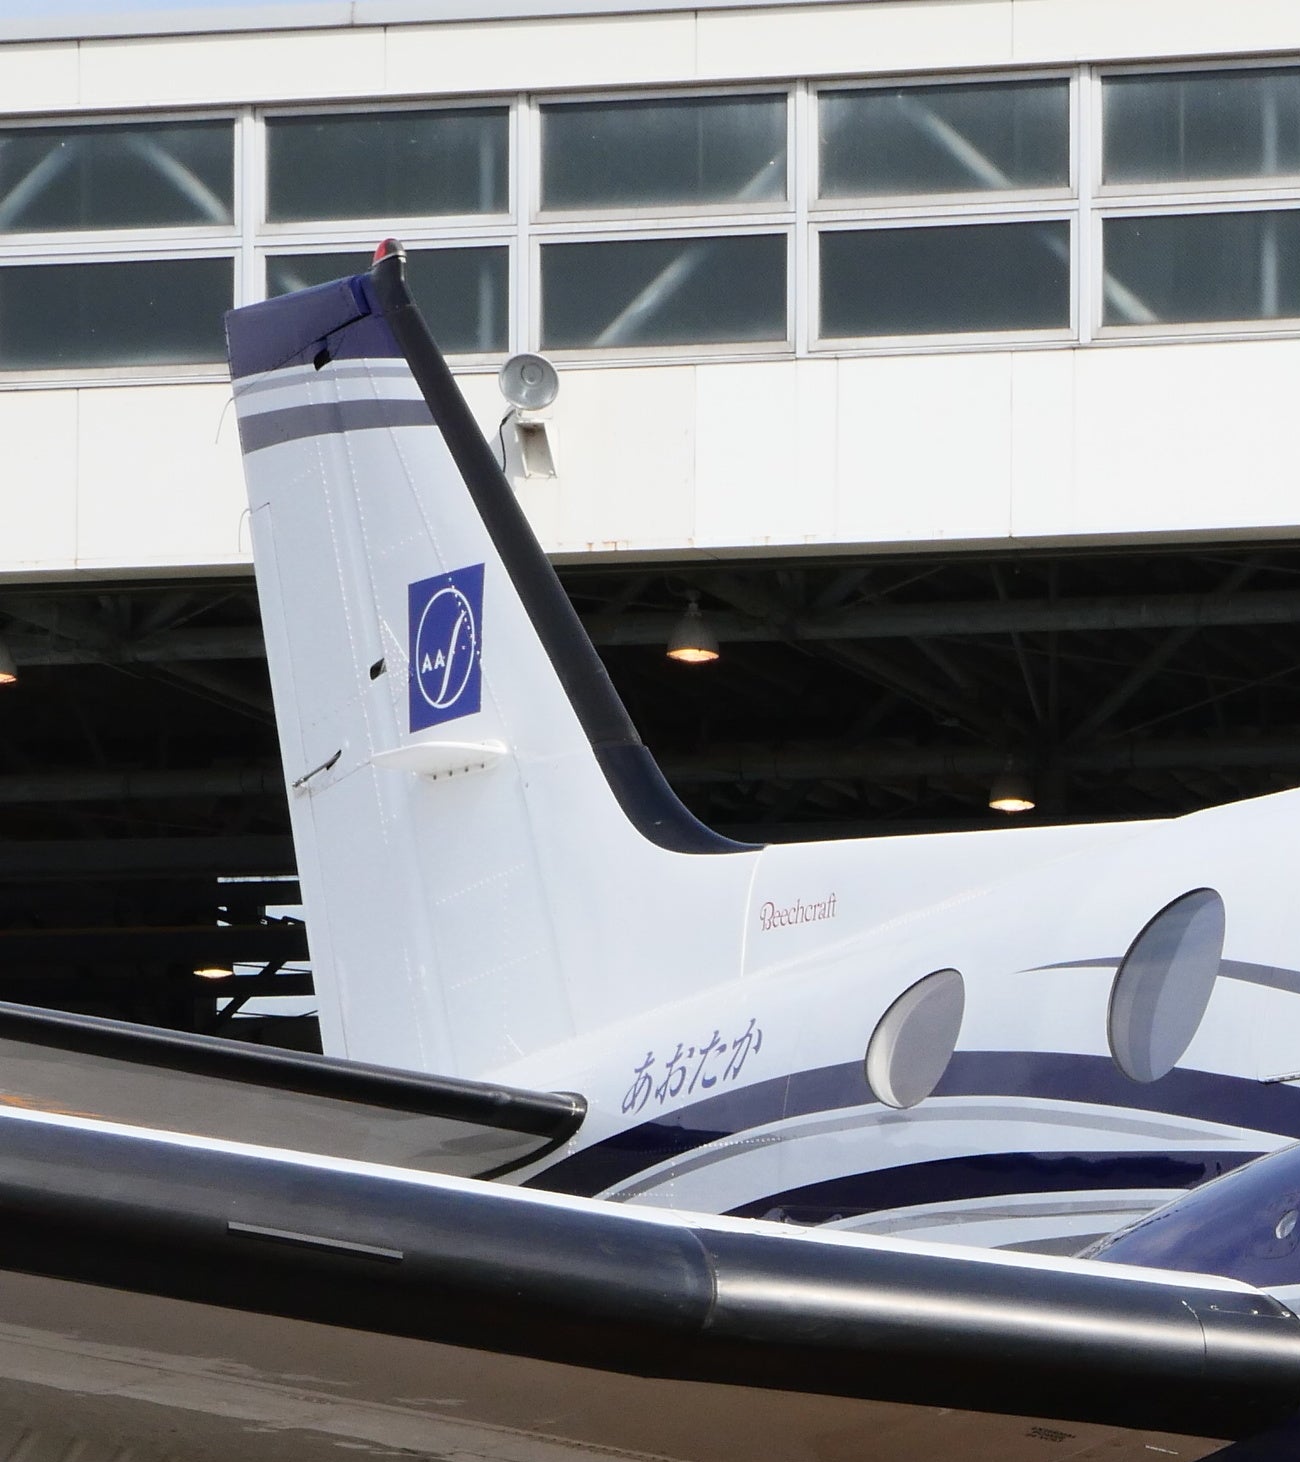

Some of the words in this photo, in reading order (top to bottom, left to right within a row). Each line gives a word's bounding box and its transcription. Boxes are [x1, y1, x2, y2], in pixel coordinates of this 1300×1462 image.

[760, 892, 837, 931] Beechcraft
[621, 1018, 763, 1114] あおたか
